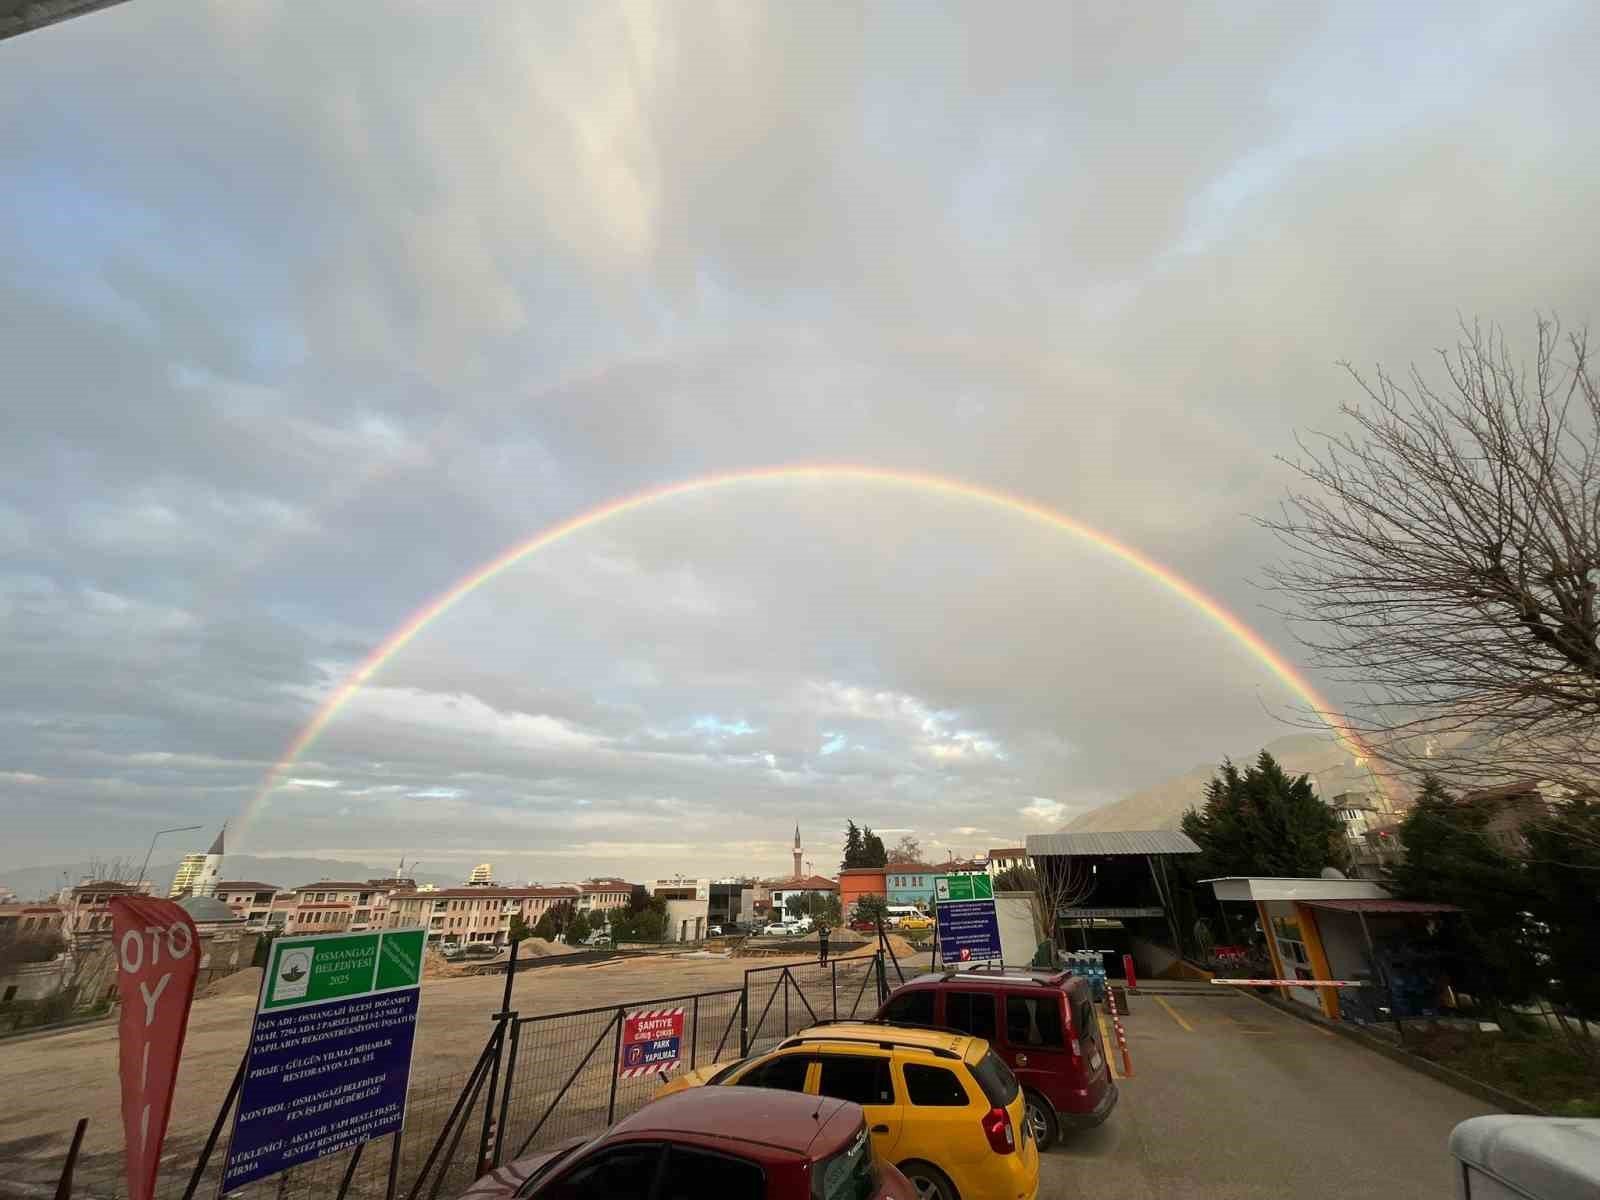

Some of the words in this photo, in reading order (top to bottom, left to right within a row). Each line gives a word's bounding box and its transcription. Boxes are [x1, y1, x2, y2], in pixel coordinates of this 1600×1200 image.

[121, 922, 192, 973] OTO
[315, 946, 375, 961] OSMANGAZİ
[315, 957, 372, 974] BELEDİYESİ
[329, 974, 350, 986] 2025
[298, 1007, 345, 1023] OSMANGAZİ
[638, 1018, 673, 1032] ŞANTİYE
[653, 1039, 670, 1049] PARK
[645, 1049, 676, 1062] YAPILMAZ
[240, 1102, 286, 1121] KONTROL
[292, 1087, 342, 1107] OSMANGAZİ
